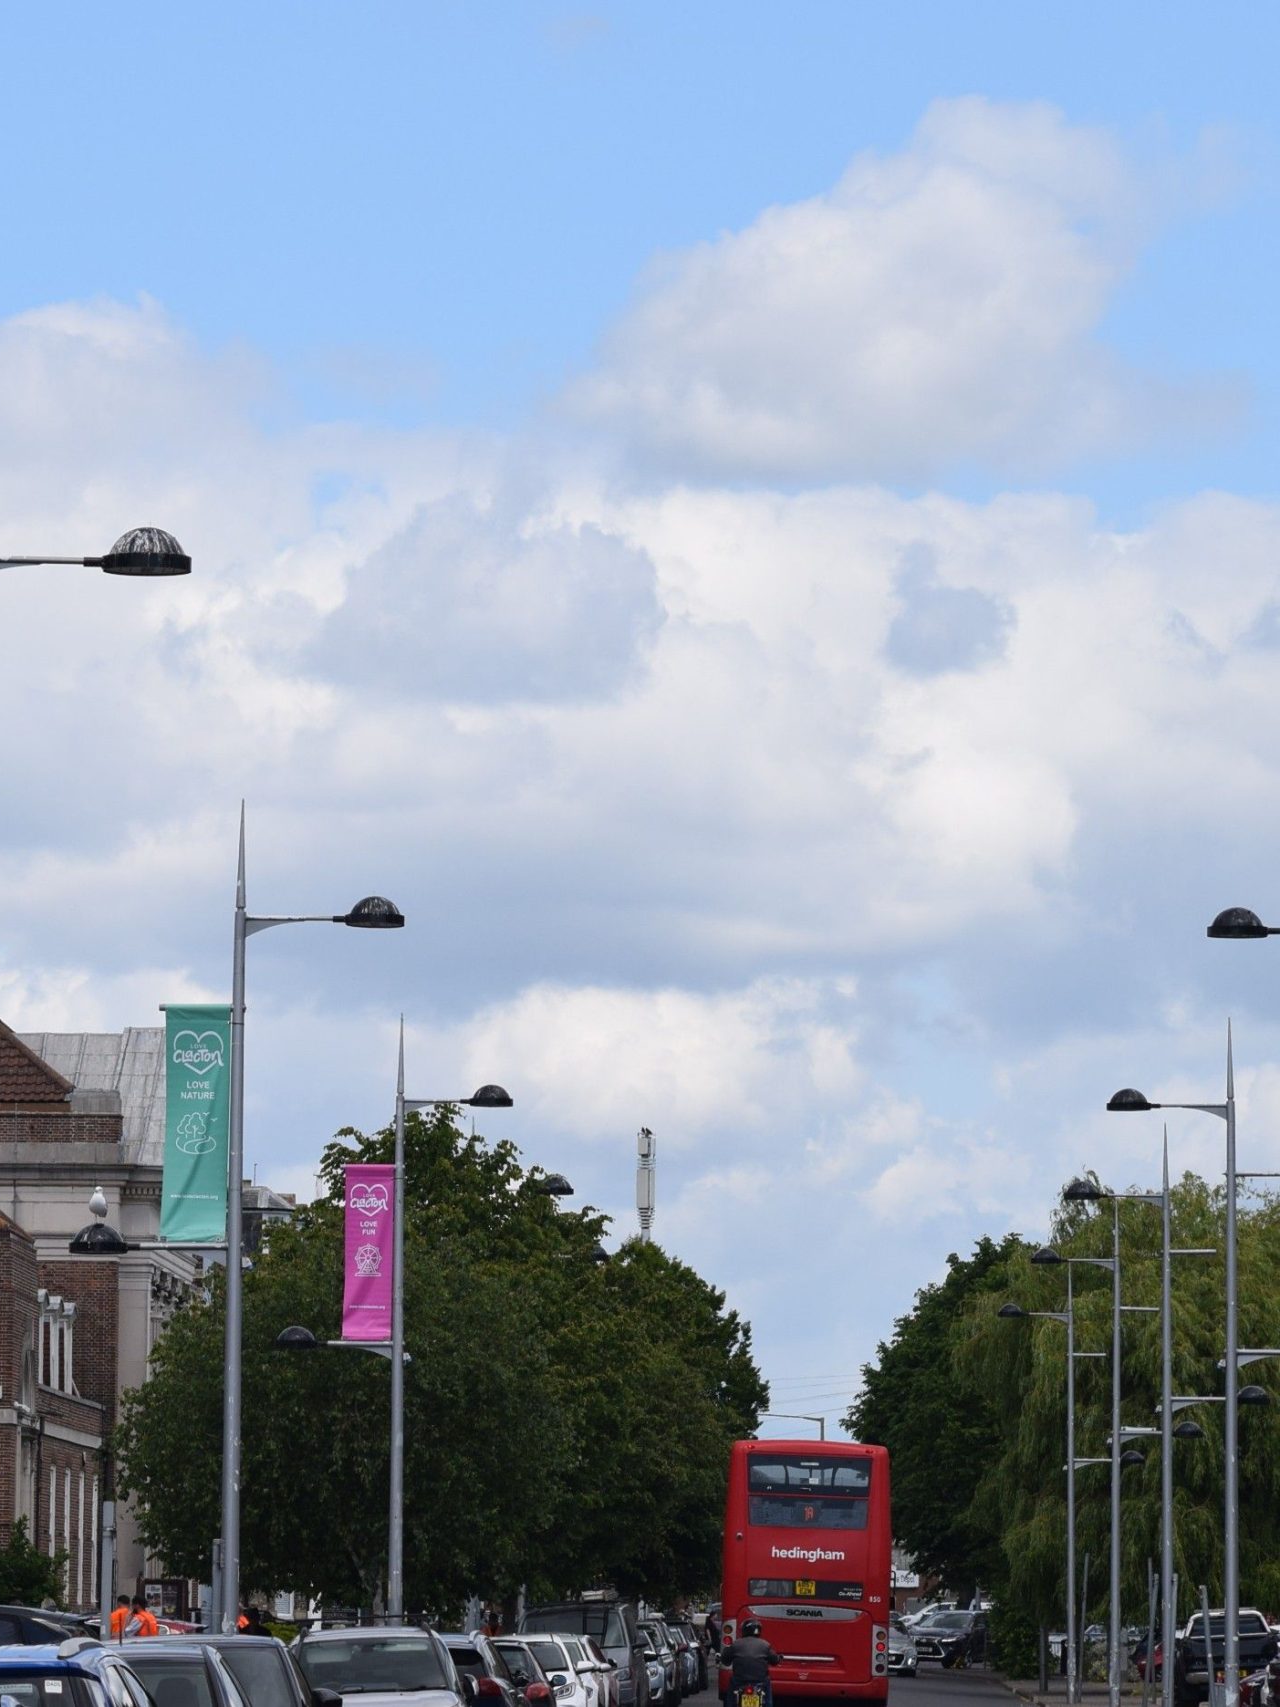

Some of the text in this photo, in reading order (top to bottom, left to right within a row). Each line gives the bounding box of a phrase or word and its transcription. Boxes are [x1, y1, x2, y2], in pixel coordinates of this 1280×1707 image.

[186, 1080, 210, 1089] LOVE
[180, 1091, 215, 1100] NATURE
[771, 1545, 845, 1563] hedingham
[785, 1608, 824, 1618] SCANIA
